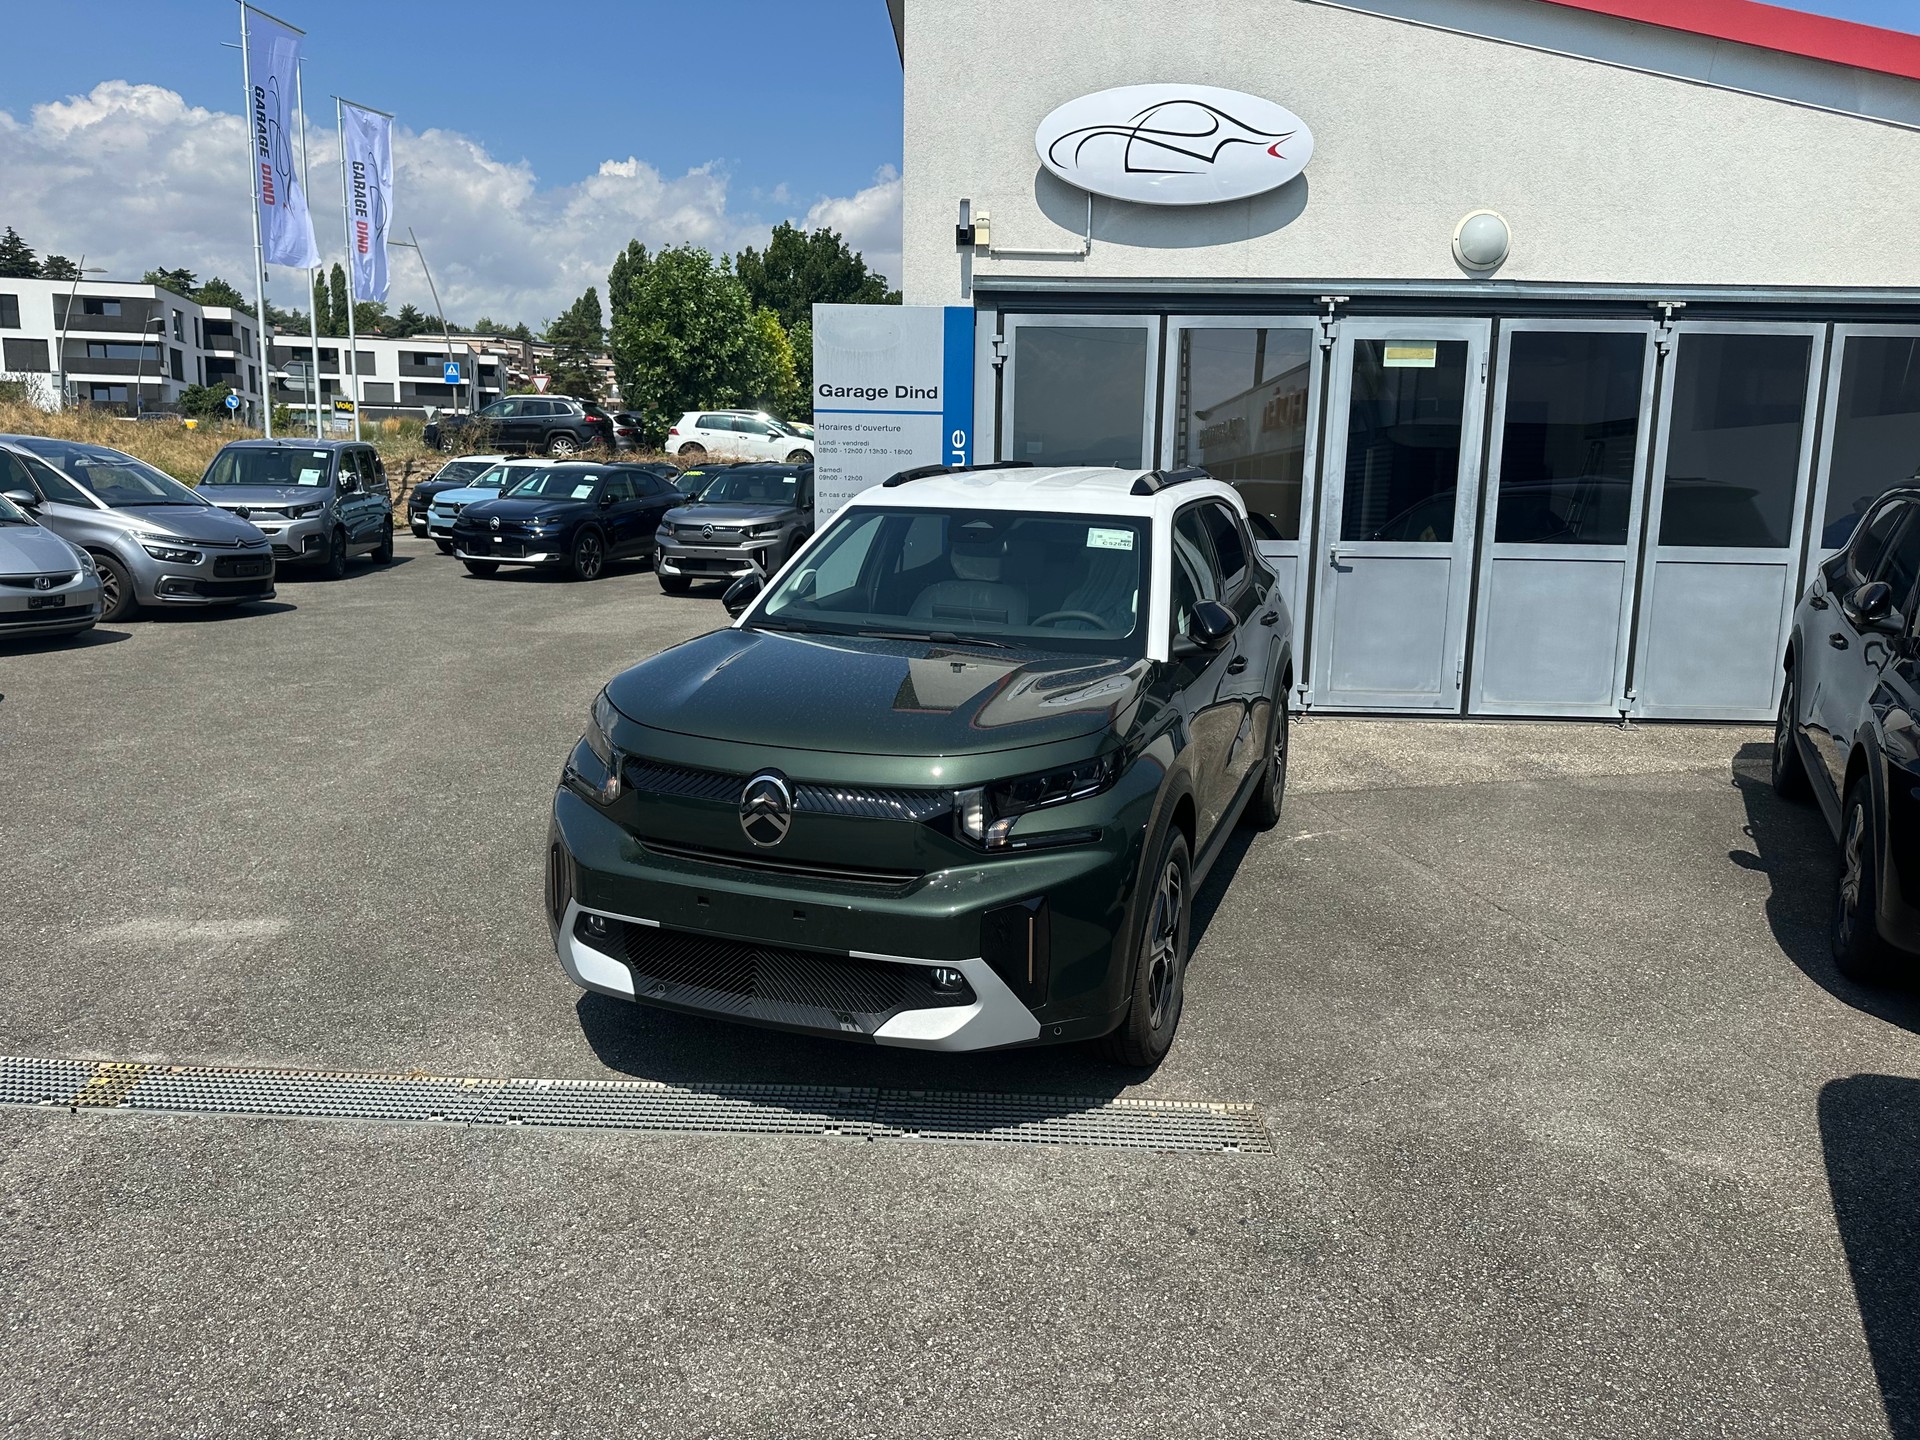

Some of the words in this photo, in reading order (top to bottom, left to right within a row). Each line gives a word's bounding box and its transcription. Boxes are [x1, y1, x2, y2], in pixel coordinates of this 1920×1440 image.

[254, 85, 270, 159] GARAGE
[261, 162, 276, 206] DIND
[352, 160, 368, 218] GARAGE
[356, 220, 369, 255] DIND
[818, 383, 889, 401] Garage
[895, 385, 938, 399] Dind
[818, 423, 853, 431] Horaires
[855, 423, 902, 433] d'ouverture
